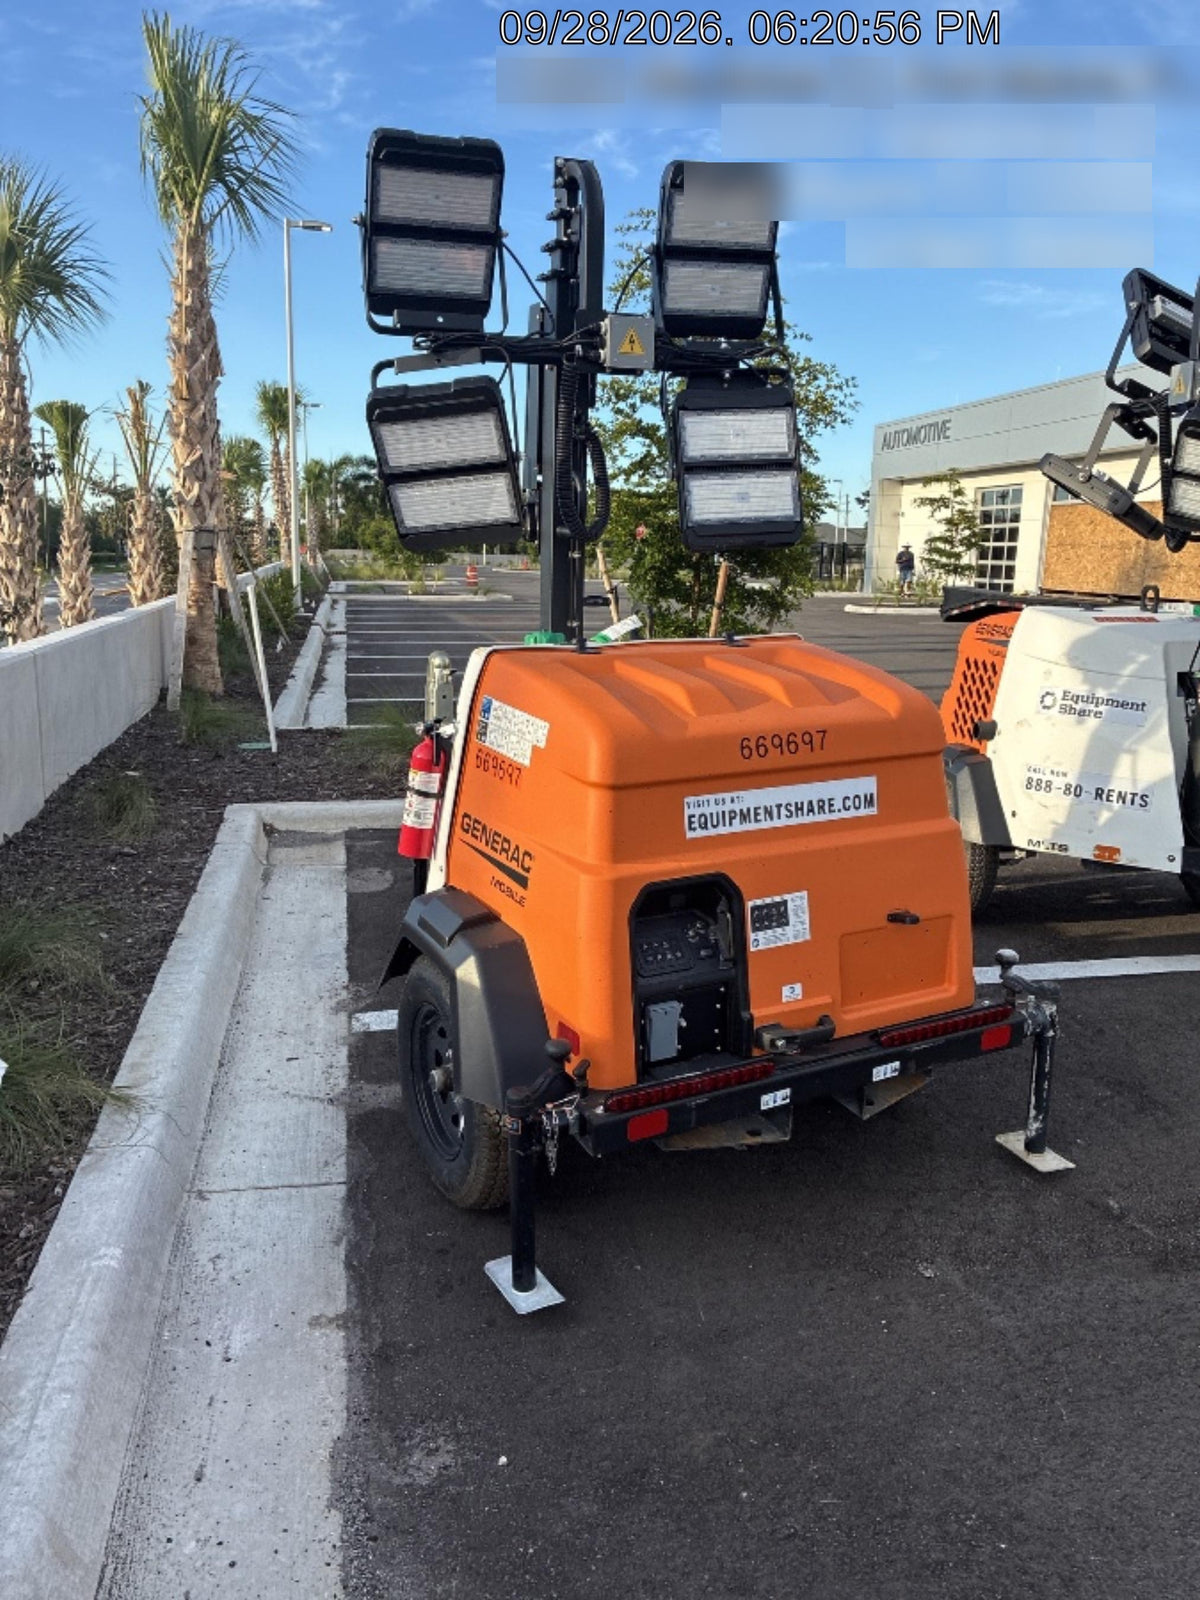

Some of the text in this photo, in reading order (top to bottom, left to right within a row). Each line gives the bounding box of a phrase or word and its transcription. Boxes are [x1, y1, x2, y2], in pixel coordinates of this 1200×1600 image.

[881, 418, 952, 452] AUTOMOTIVE
[1058, 703, 1104, 719] Share
[1060, 689, 1147, 713] Equipment
[739, 730, 828, 760] 669697
[686, 797, 711, 810] VISIT
[714, 796, 726, 806] US
[687, 792, 876, 832] EQUIPMENTSHARE.COM
[460, 811, 534, 874] GENERAC
